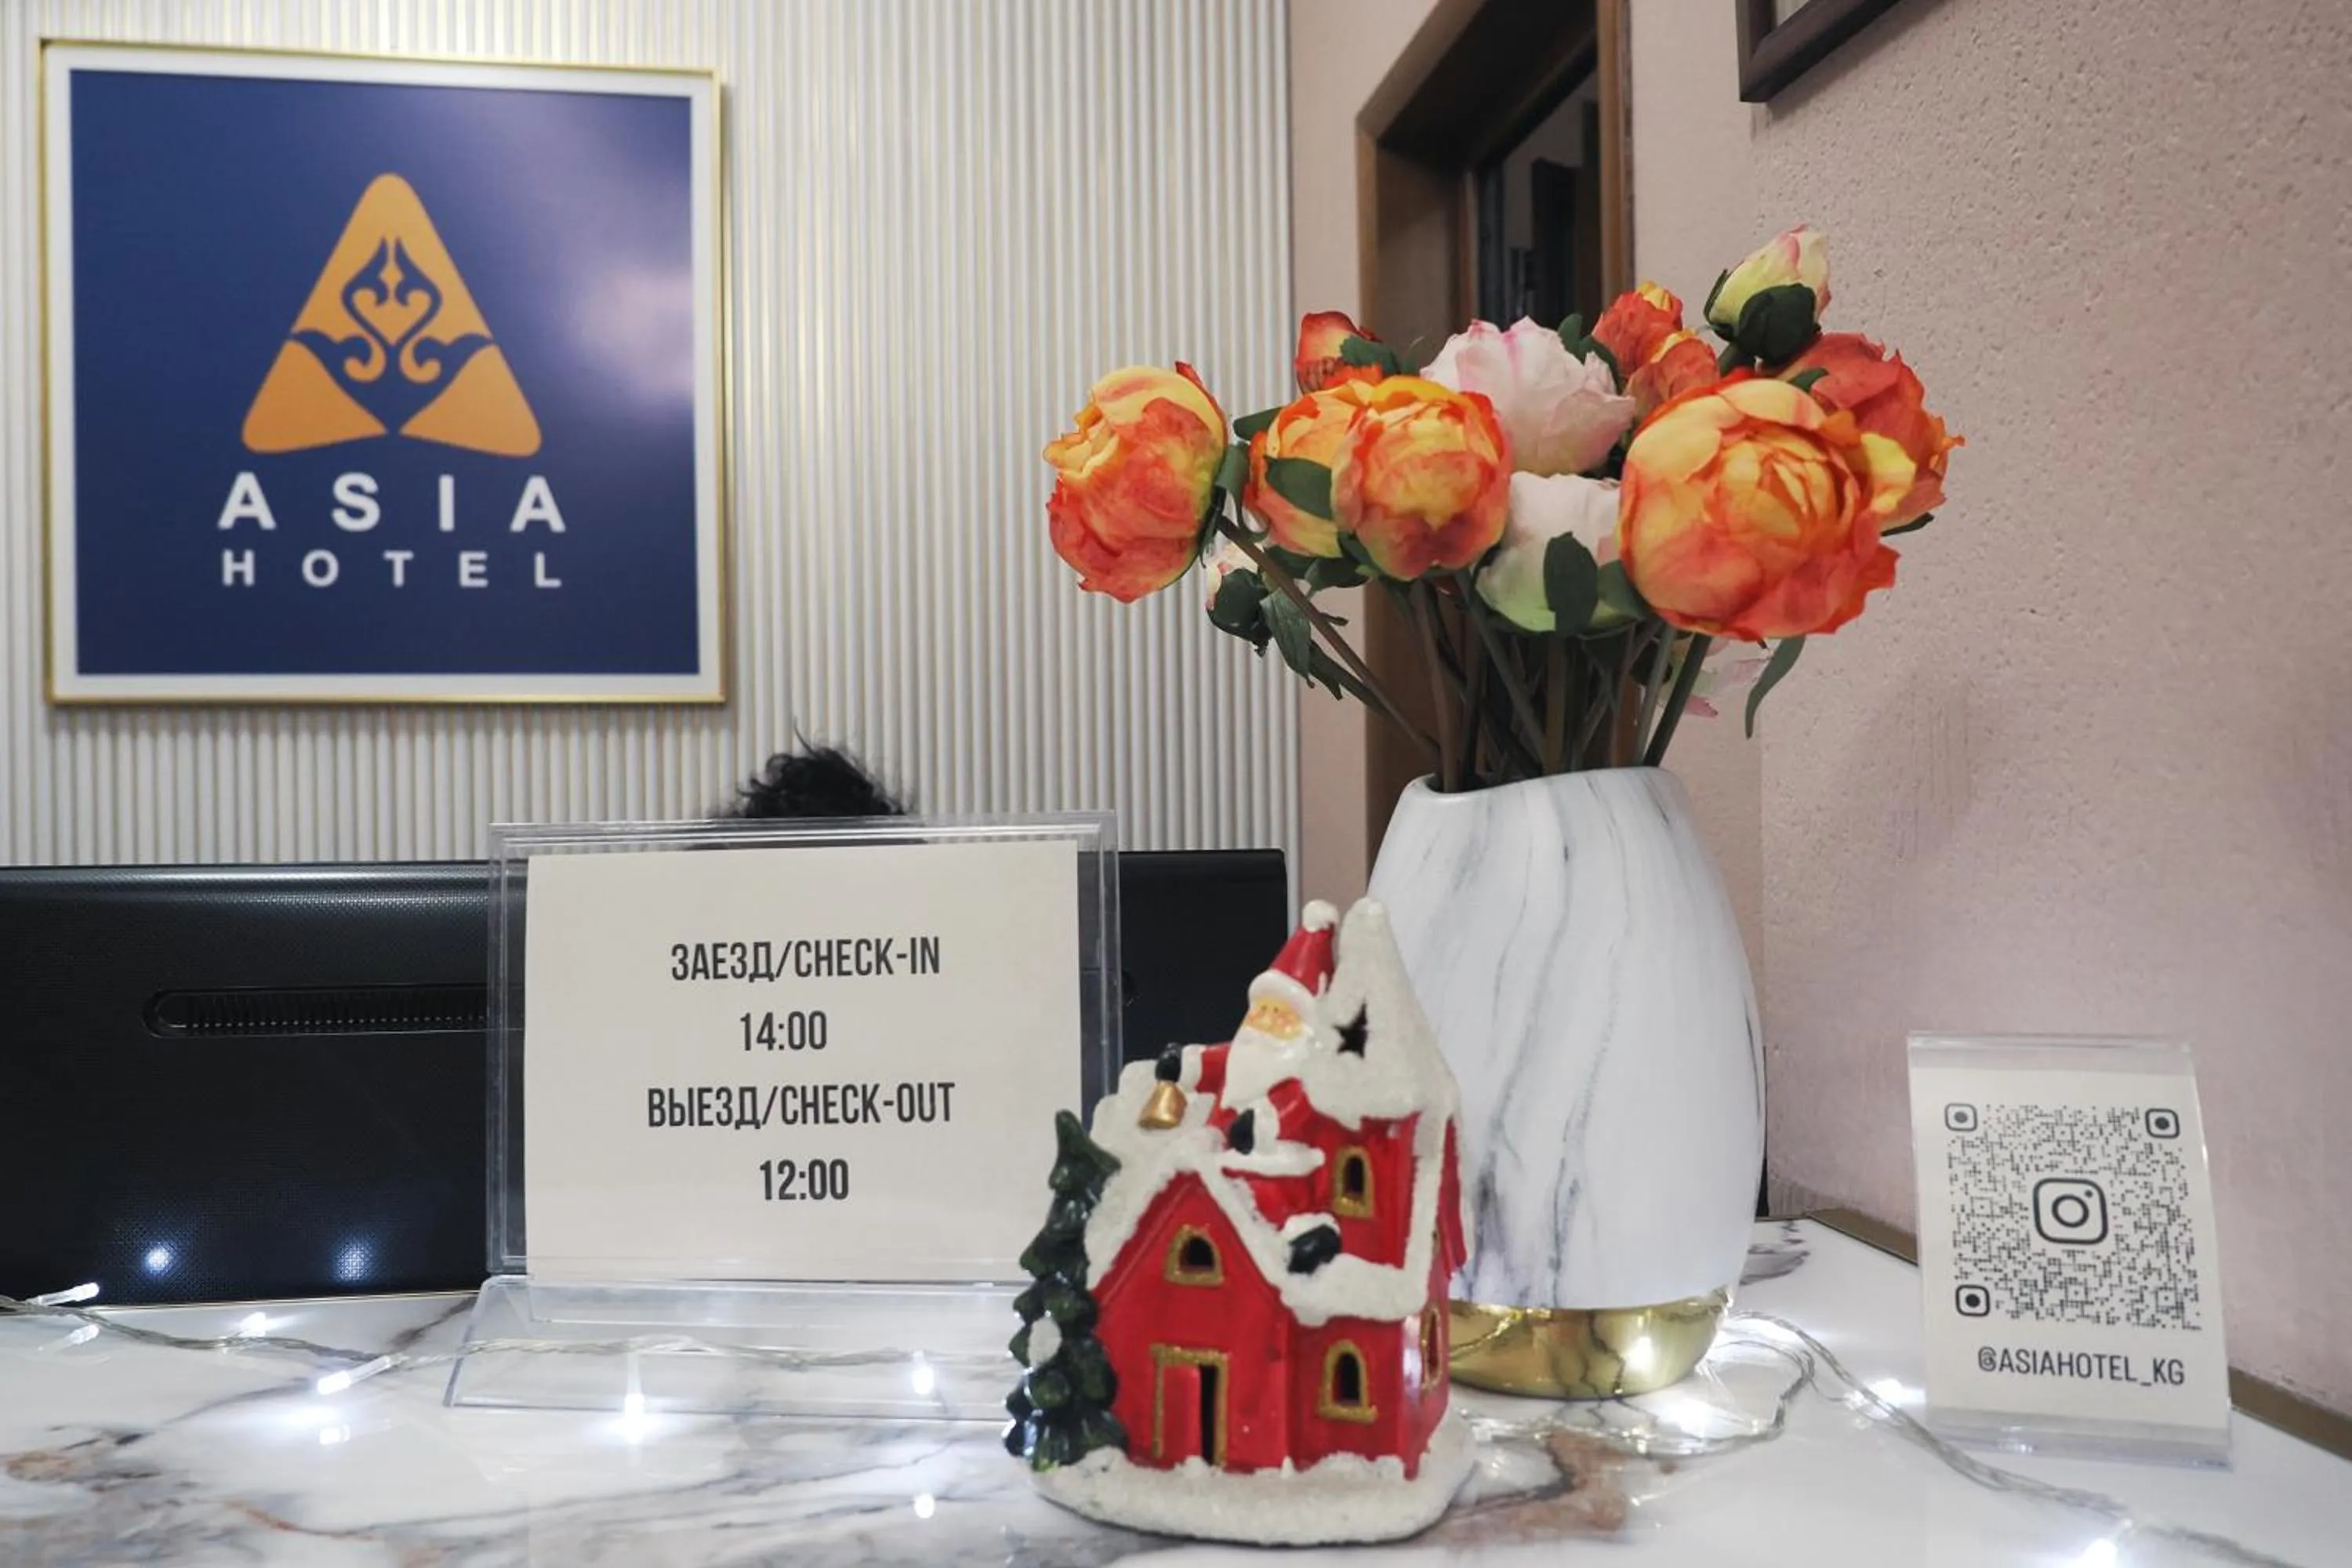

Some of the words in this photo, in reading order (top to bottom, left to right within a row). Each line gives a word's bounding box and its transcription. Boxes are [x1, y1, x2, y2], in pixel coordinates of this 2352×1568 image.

[218, 472, 566, 532] ASIA
[222, 549, 563, 588] HOTEL
[671, 936, 941, 983] ЗАЕЗД/CHECK-IN
[739, 1010, 828, 1051] 14:00
[647, 1082, 956, 1131] ВЫЕЗД/CHECK-OUT
[758, 1158, 850, 1201] 12:00
[1976, 1346, 2186, 1388] @ASIAHOTEL_KG
